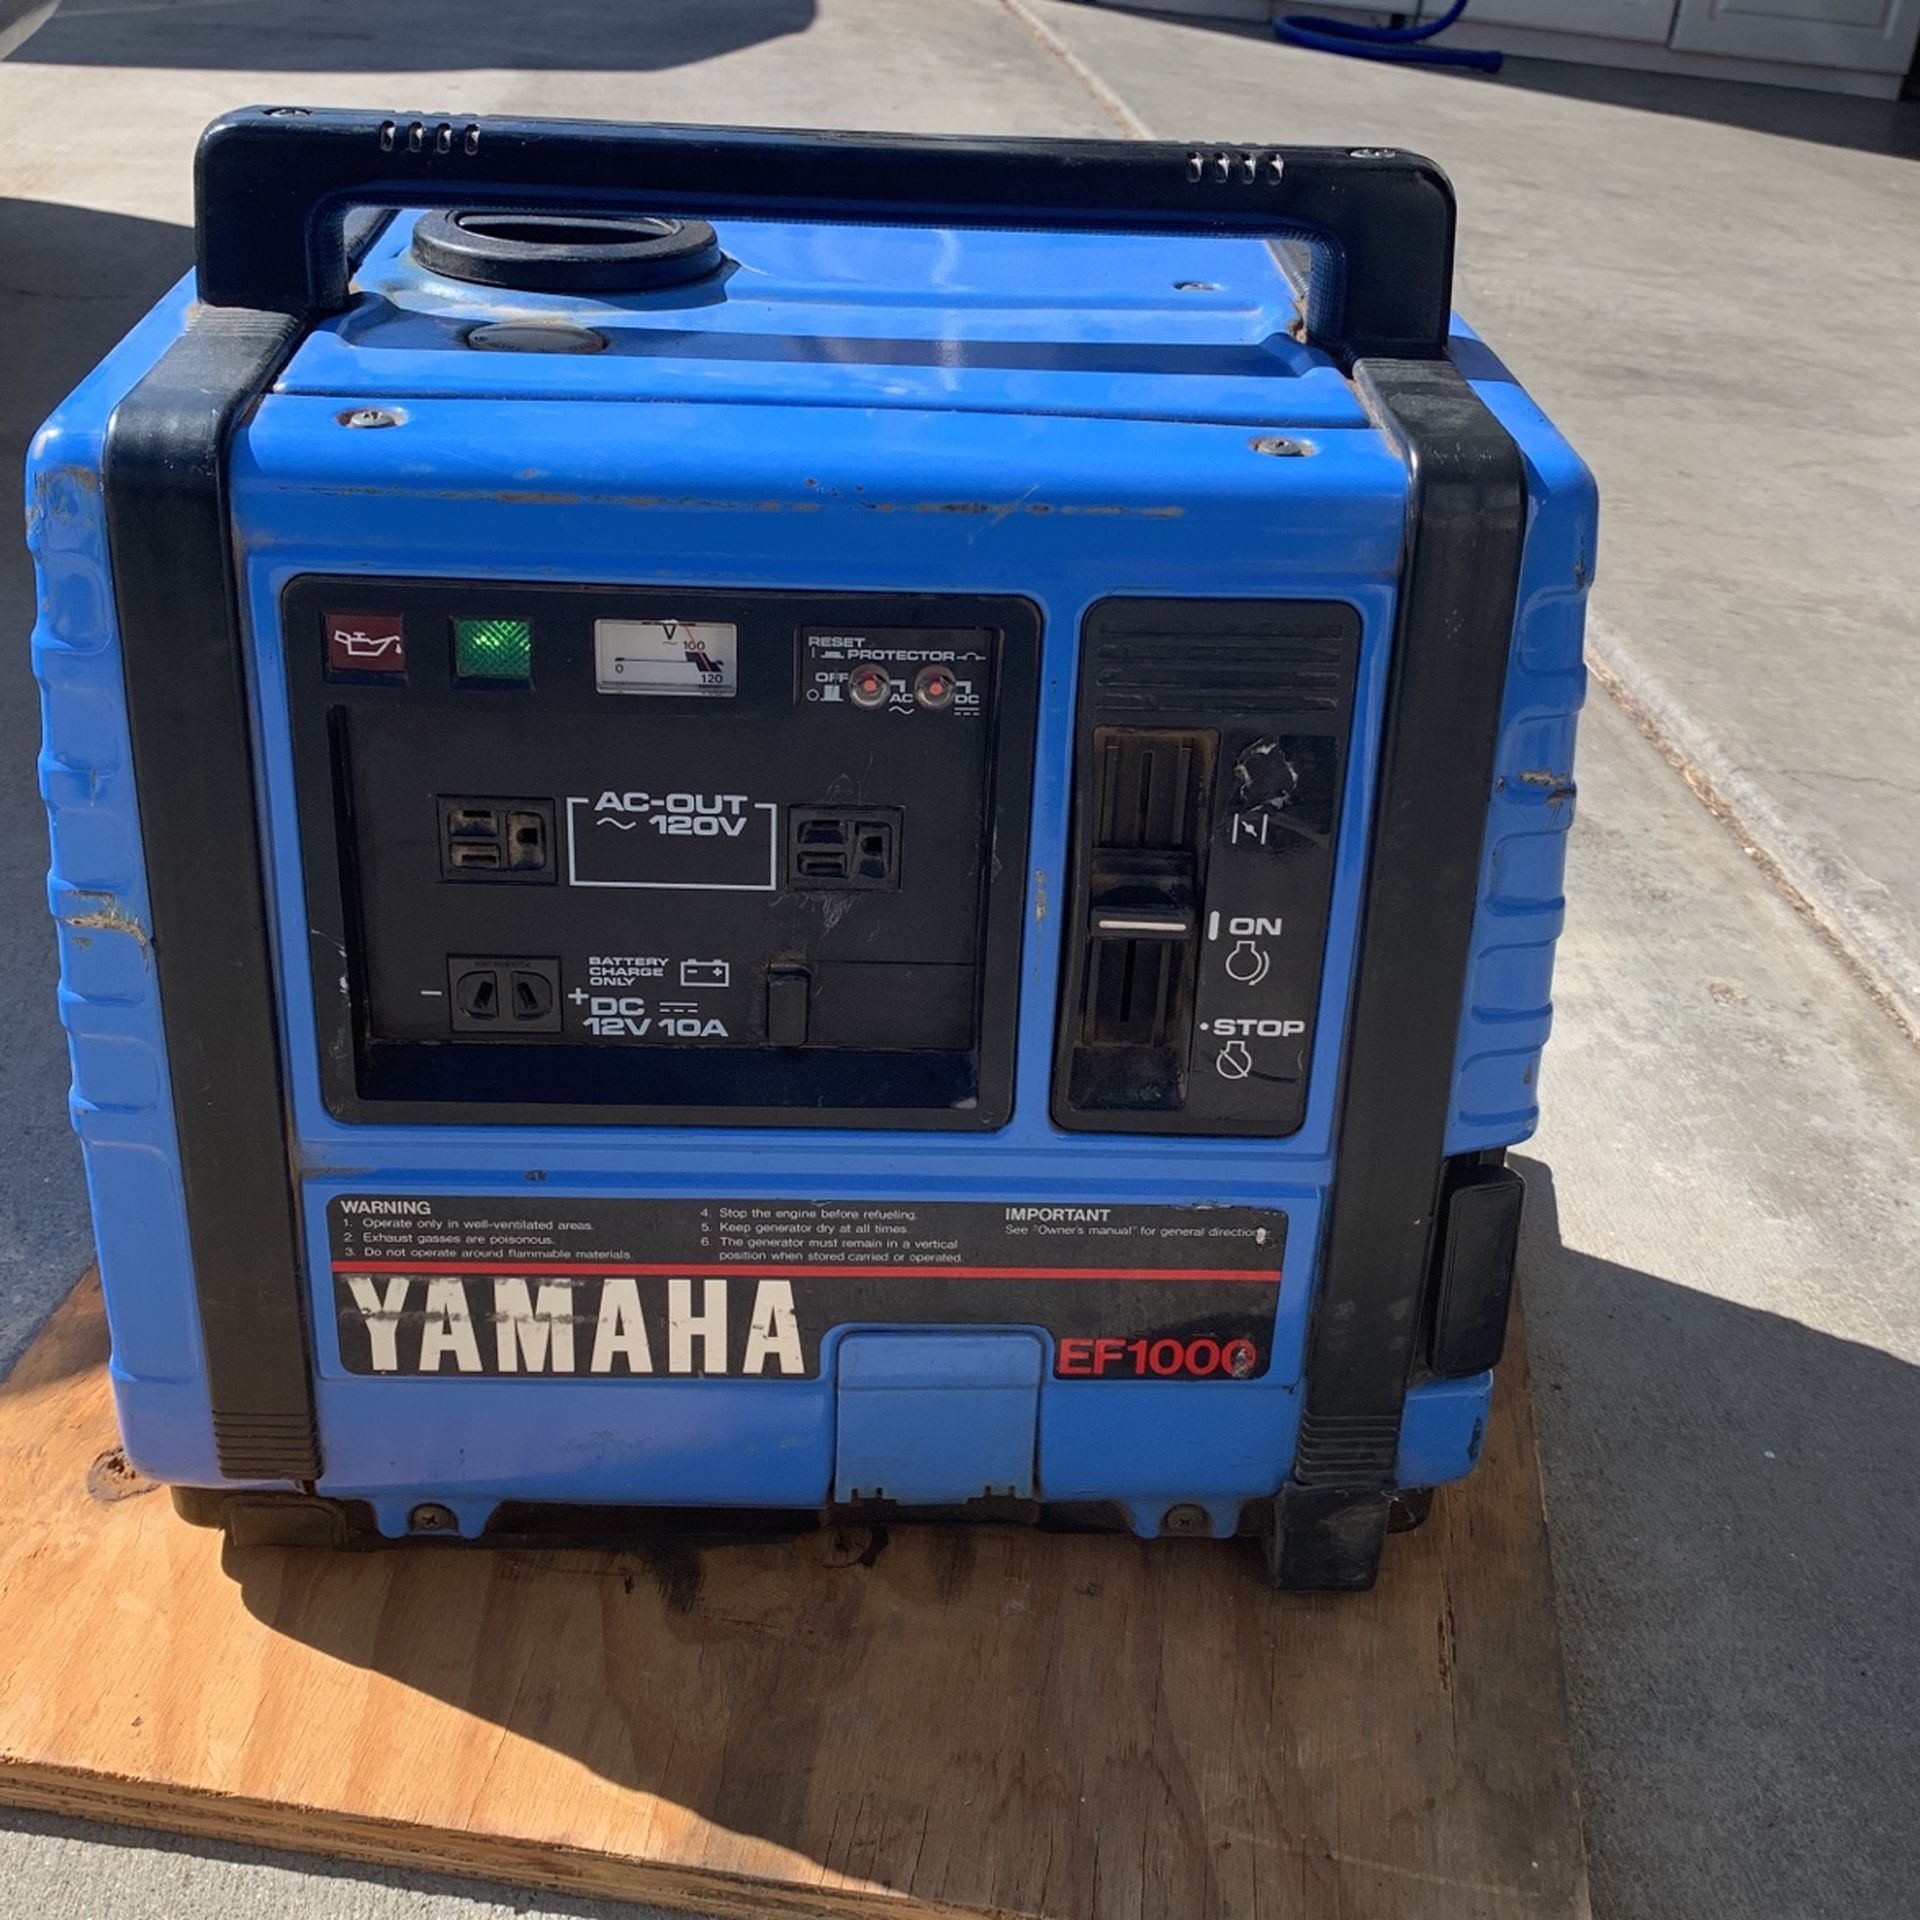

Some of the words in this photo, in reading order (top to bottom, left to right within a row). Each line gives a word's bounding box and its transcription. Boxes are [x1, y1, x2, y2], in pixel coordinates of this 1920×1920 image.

[662, 623, 677, 640] V
[683, 640, 706, 651] 100
[808, 636, 866, 648] RESET
[847, 649, 955, 662] PROTECTOR
[615, 664, 624, 674] 0
[701, 674, 723, 684] 120
[815, 671, 849, 683] OFF
[889, 693, 914, 704] AC
[954, 694, 980, 705] DC
[594, 791, 748, 815] AC-OUT
[648, 814, 747, 837] 120V
[1228, 917, 1282, 936] ON
[588, 956, 669, 967] BATTERY
[588, 966, 664, 977] CHARGE
[589, 976, 636, 987] ONLY
[590, 997, 645, 1017] DC
[582, 1017, 652, 1036] 12V
[658, 1018, 729, 1037] 10A
[1213, 1018, 1305, 1037] STOP
[340, 1200, 432, 1216] WARNING
[719, 1207, 748, 1219] Stop
[751, 1208, 772, 1219] the
[775, 1210, 817, 1220] engine
[820, 1209, 859, 1220] before
[863, 1210, 917, 1221] refueling.
[1005, 1207, 1111, 1222] IMPORTANT
[362, 1218, 414, 1230] Operate
[416, 1219, 443, 1230] only
[448, 1219, 460, 1229] in
[463, 1219, 554, 1231] well-ventilated
[719, 1222, 752, 1233] Keep
[755, 1223, 812, 1234] generator
[816, 1223, 835, 1235] dry
[839, 1224, 852, 1234] at
[855, 1224, 870, 1234] all
[1004, 1224, 1029, 1235] See
[1140, 1226, 1156, 1236] for
[1160, 1227, 1205, 1238] general
[362, 1232, 413, 1244] Exhaust
[465, 1236, 486, 1245] are
[489, 1235, 557, 1246] poisonous.
[720, 1237, 744, 1247] The
[747, 1239, 804, 1249] generator
[808, 1239, 838, 1249] must
[842, 1239, 882, 1249] remain
[886, 1239, 898, 1249] in
[902, 1240, 911, 1249] a
[914, 1240, 958, 1250] vertical
[364, 1247, 383, 1258] Do
[386, 1248, 407, 1258] not
[410, 1249, 458, 1260] operate
[461, 1249, 505, 1259] around
[508, 1249, 572, 1260] flammable
[719, 1252, 766, 1262] position
[771, 1252, 803, 1261] when
[807, 1252, 845, 1262] stored
[847, 1252, 889, 1262] carried
[892, 1253, 905, 1262] or
[348, 1277, 805, 1375] YAMAHA
[1058, 1338, 1257, 1376] EF1000
